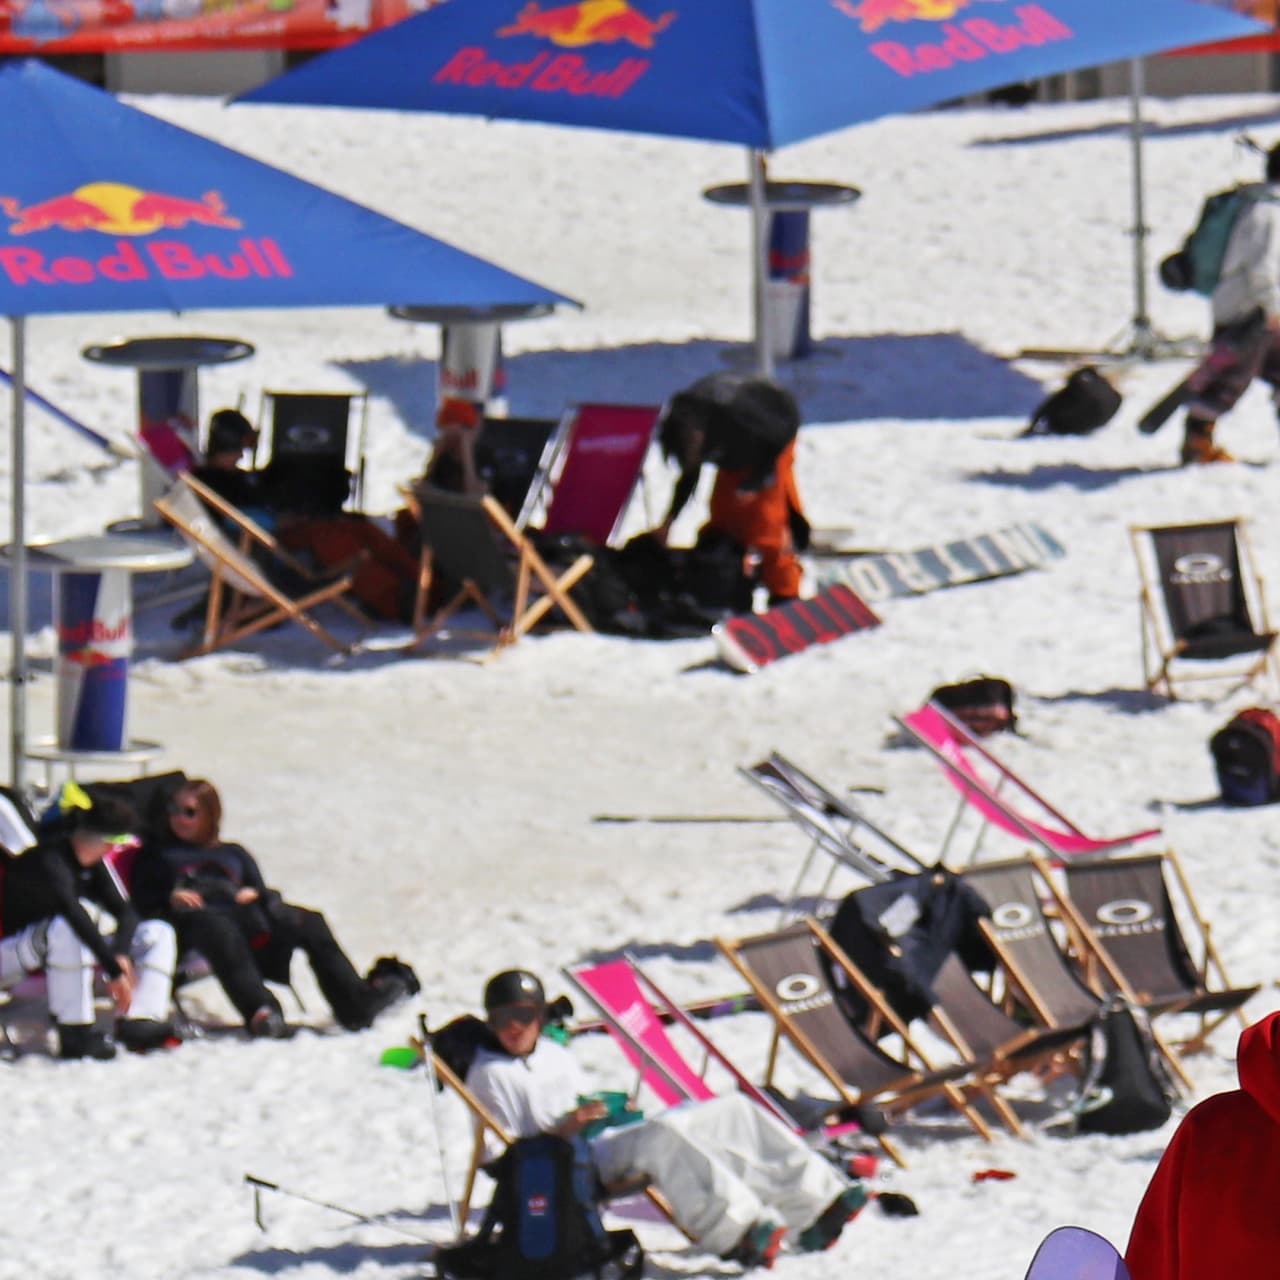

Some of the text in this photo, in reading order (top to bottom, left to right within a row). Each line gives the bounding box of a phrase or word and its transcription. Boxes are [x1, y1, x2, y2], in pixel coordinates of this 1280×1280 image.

[869, 5, 1073, 77] Red Bull
[434, 47, 650, 98] Red Bull
[147, 237, 294, 280] Bull
